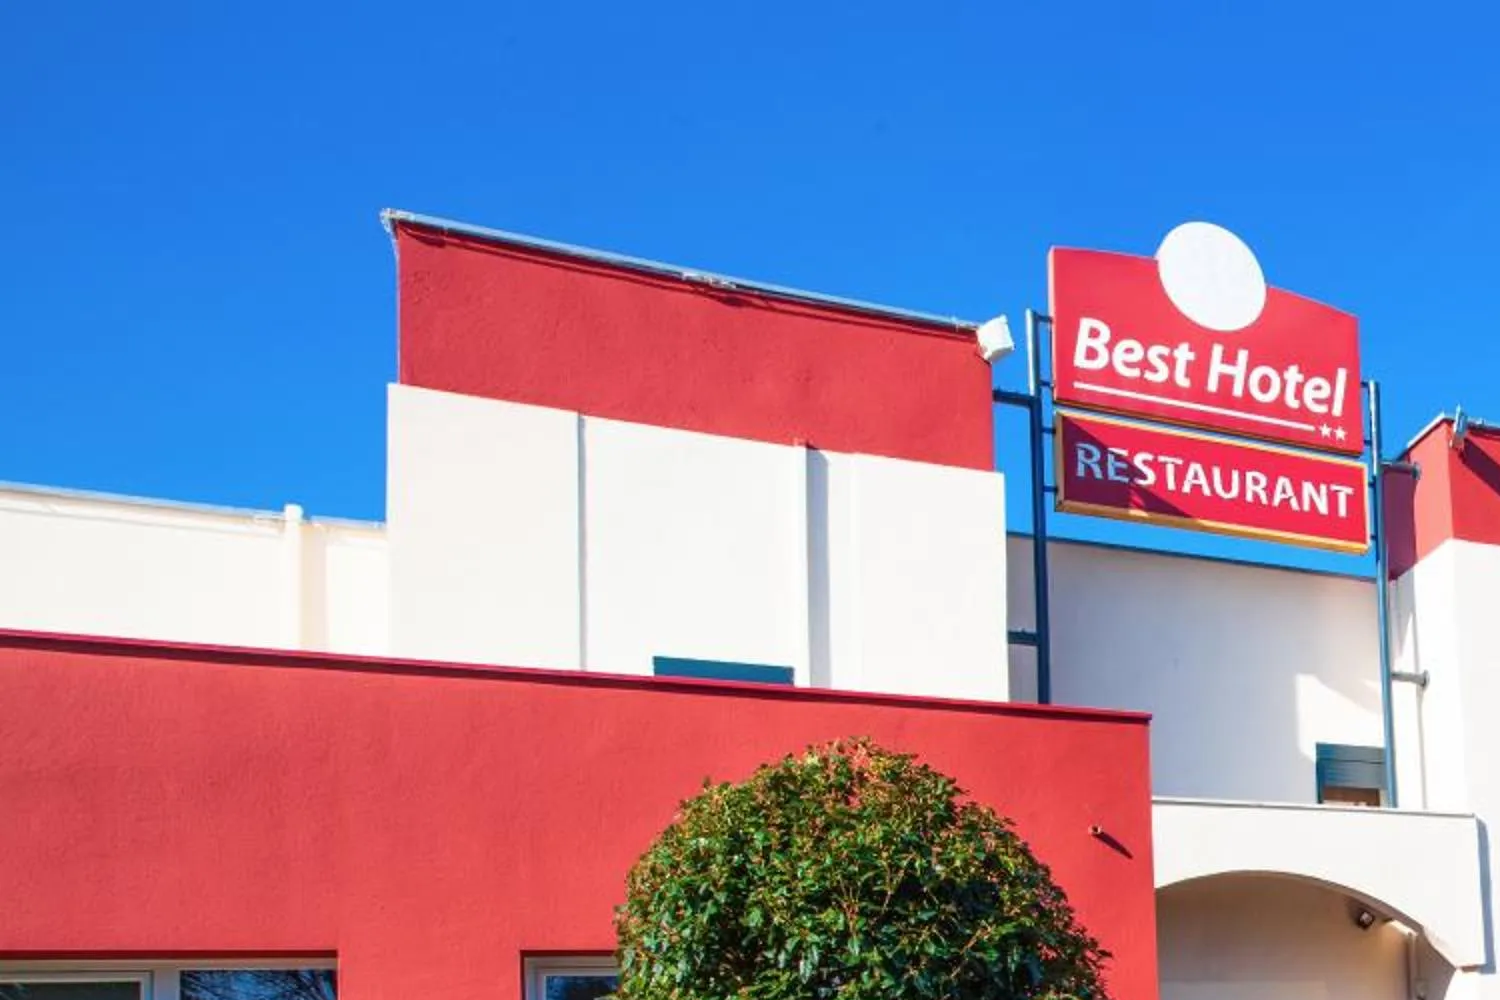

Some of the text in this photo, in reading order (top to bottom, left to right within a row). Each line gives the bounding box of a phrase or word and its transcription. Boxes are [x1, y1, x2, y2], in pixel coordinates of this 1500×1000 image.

[1073, 316, 1348, 418] Best Hotel
[1075, 442, 1355, 519] RESTAURANT
